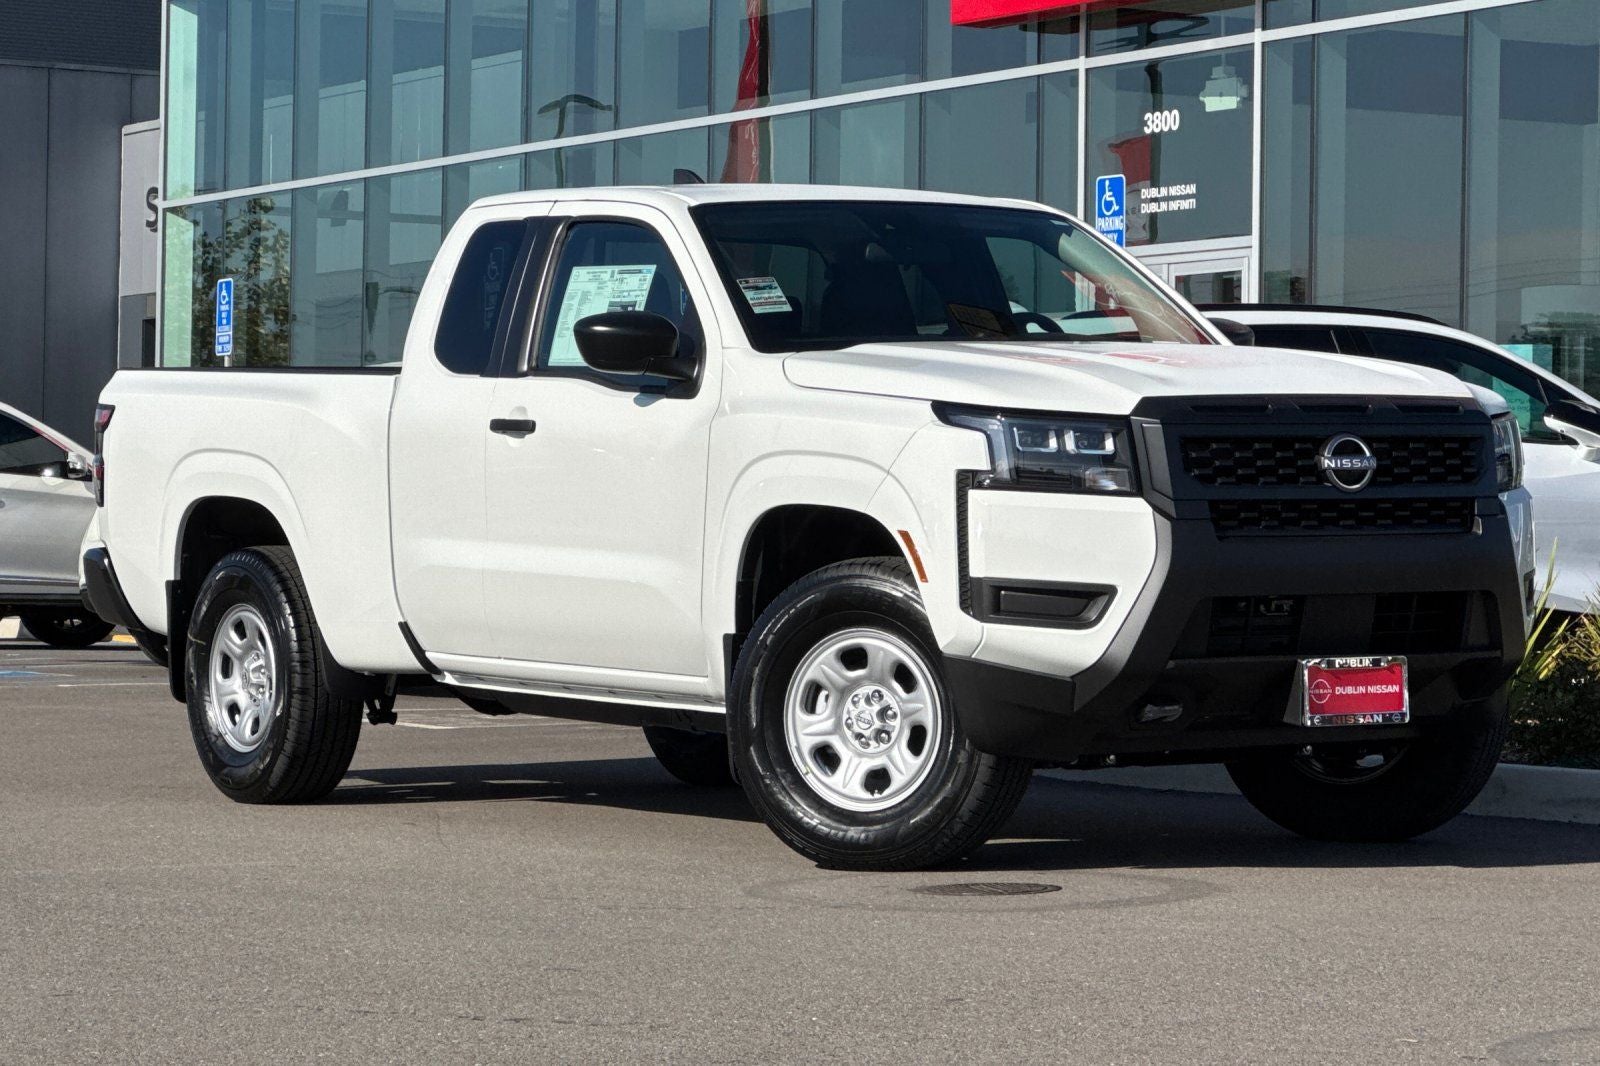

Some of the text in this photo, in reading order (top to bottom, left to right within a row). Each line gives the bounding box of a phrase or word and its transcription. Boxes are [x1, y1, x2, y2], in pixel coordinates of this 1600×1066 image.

[1144, 109, 1180, 134] 3800
[1141, 184, 1196, 199] DUBLIN NISSAN
[1141, 201, 1168, 213] DUBLIN
[1169, 199, 1196, 211] INFINITI
[1097, 215, 1124, 231] PARKING
[1324, 458, 1376, 468] NISSAN
[1335, 658, 1373, 668] DUBLIN
[1335, 684, 1400, 695] DUBLIN NISSAN
[1333, 714, 1383, 724] NISSAN
